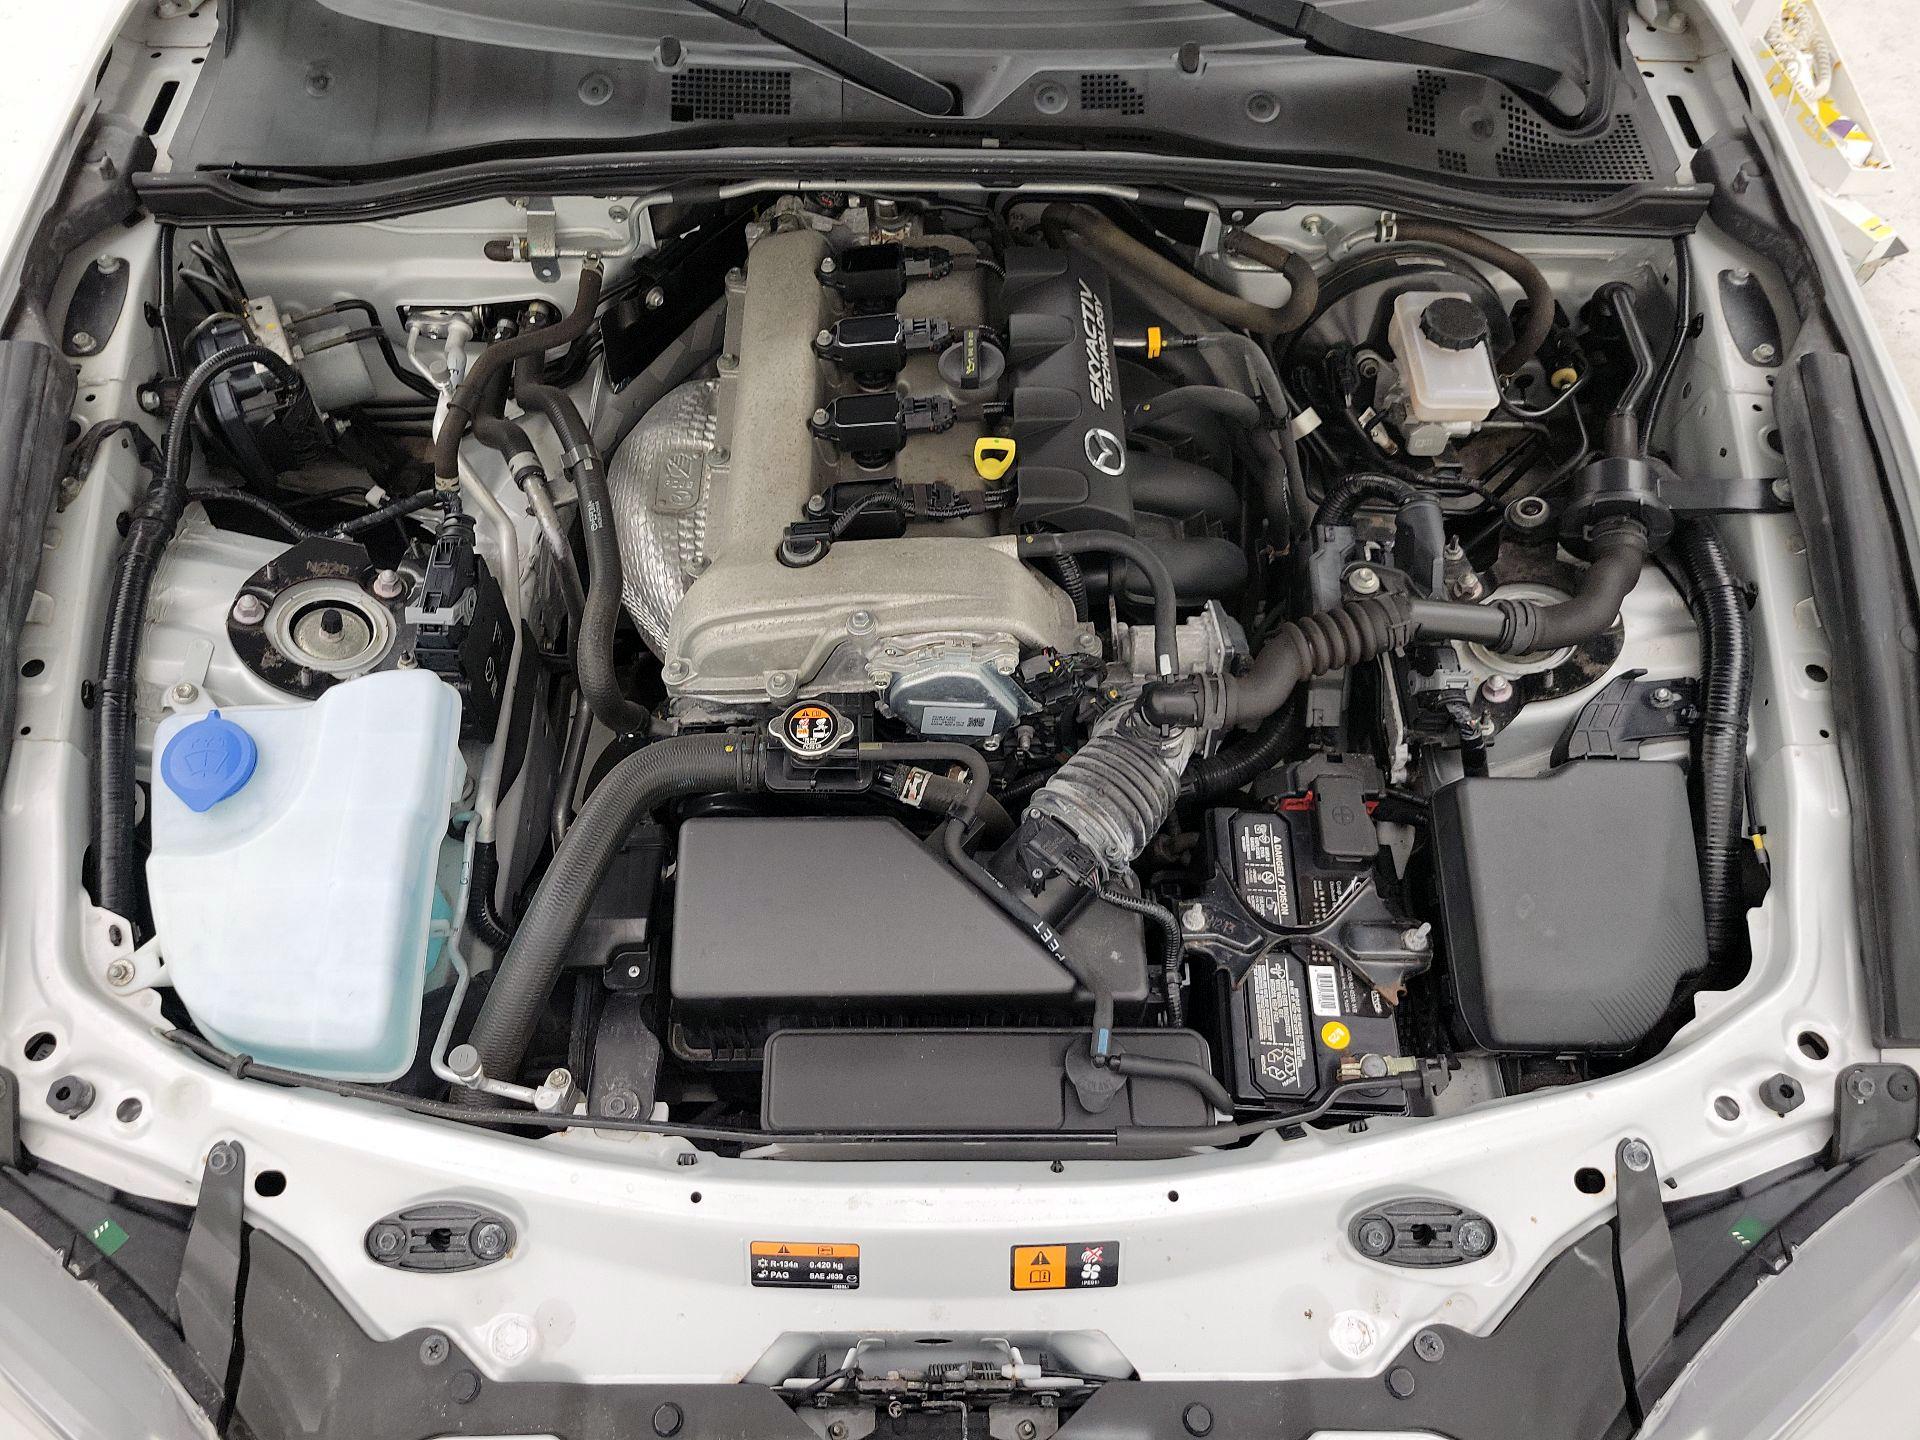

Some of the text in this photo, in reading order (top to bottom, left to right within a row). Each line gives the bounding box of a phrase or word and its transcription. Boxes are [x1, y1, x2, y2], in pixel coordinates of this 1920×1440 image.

[1078, 277, 1106, 412] SKYACTIV
[1093, 293, 1114, 402] TECHNOLOGY
[1273, 844, 1285, 877] DANGER
[1278, 884, 1290, 916] POISON
[770, 1260, 844, 1271] R-134a 0.420 kg
[770, 1271, 790, 1279] PAG
[809, 1272, 825, 1280] SAE
